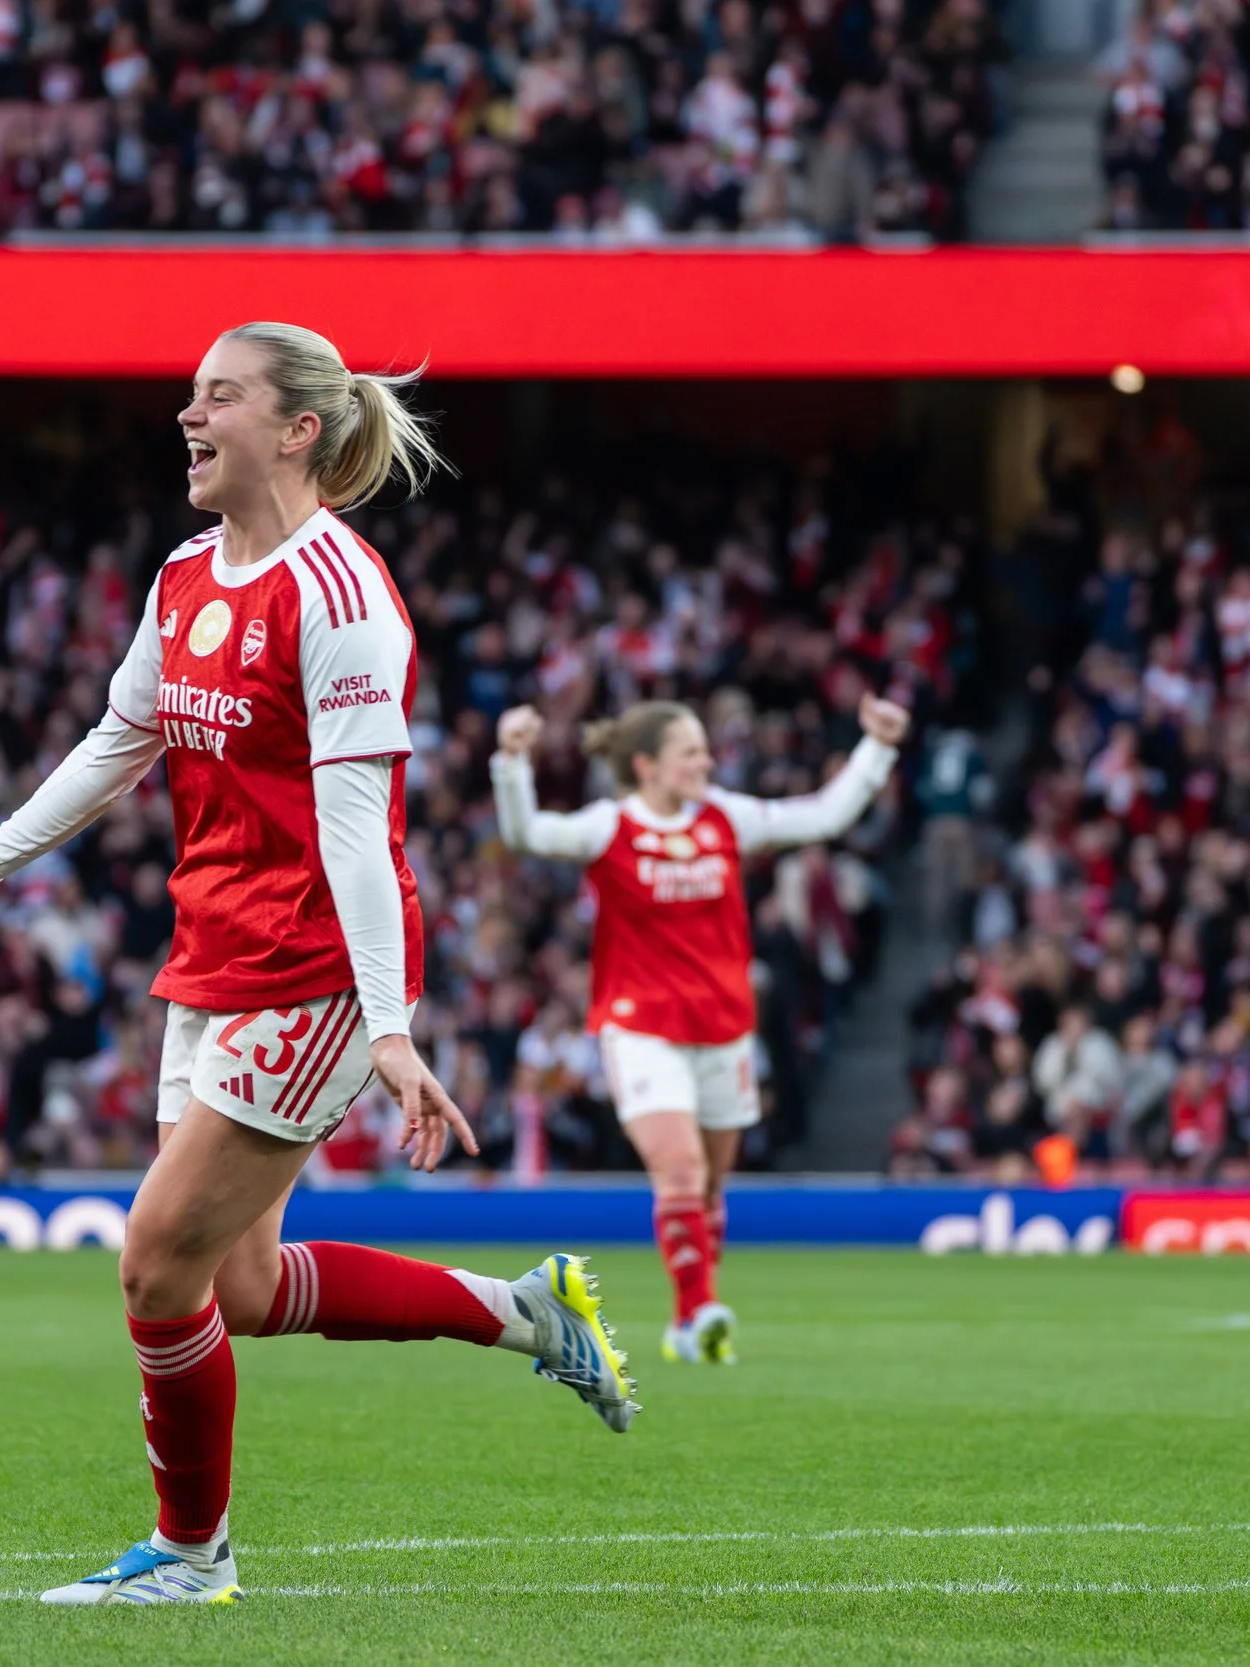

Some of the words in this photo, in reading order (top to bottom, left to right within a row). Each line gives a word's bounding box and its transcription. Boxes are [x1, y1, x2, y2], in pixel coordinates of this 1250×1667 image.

[157, 674, 253, 728] mirates
[319, 688, 392, 713] RWANDA
[331, 674, 371, 693] VISIT
[182, 721, 227, 761] BETER
[215, 1004, 313, 1075] 23
